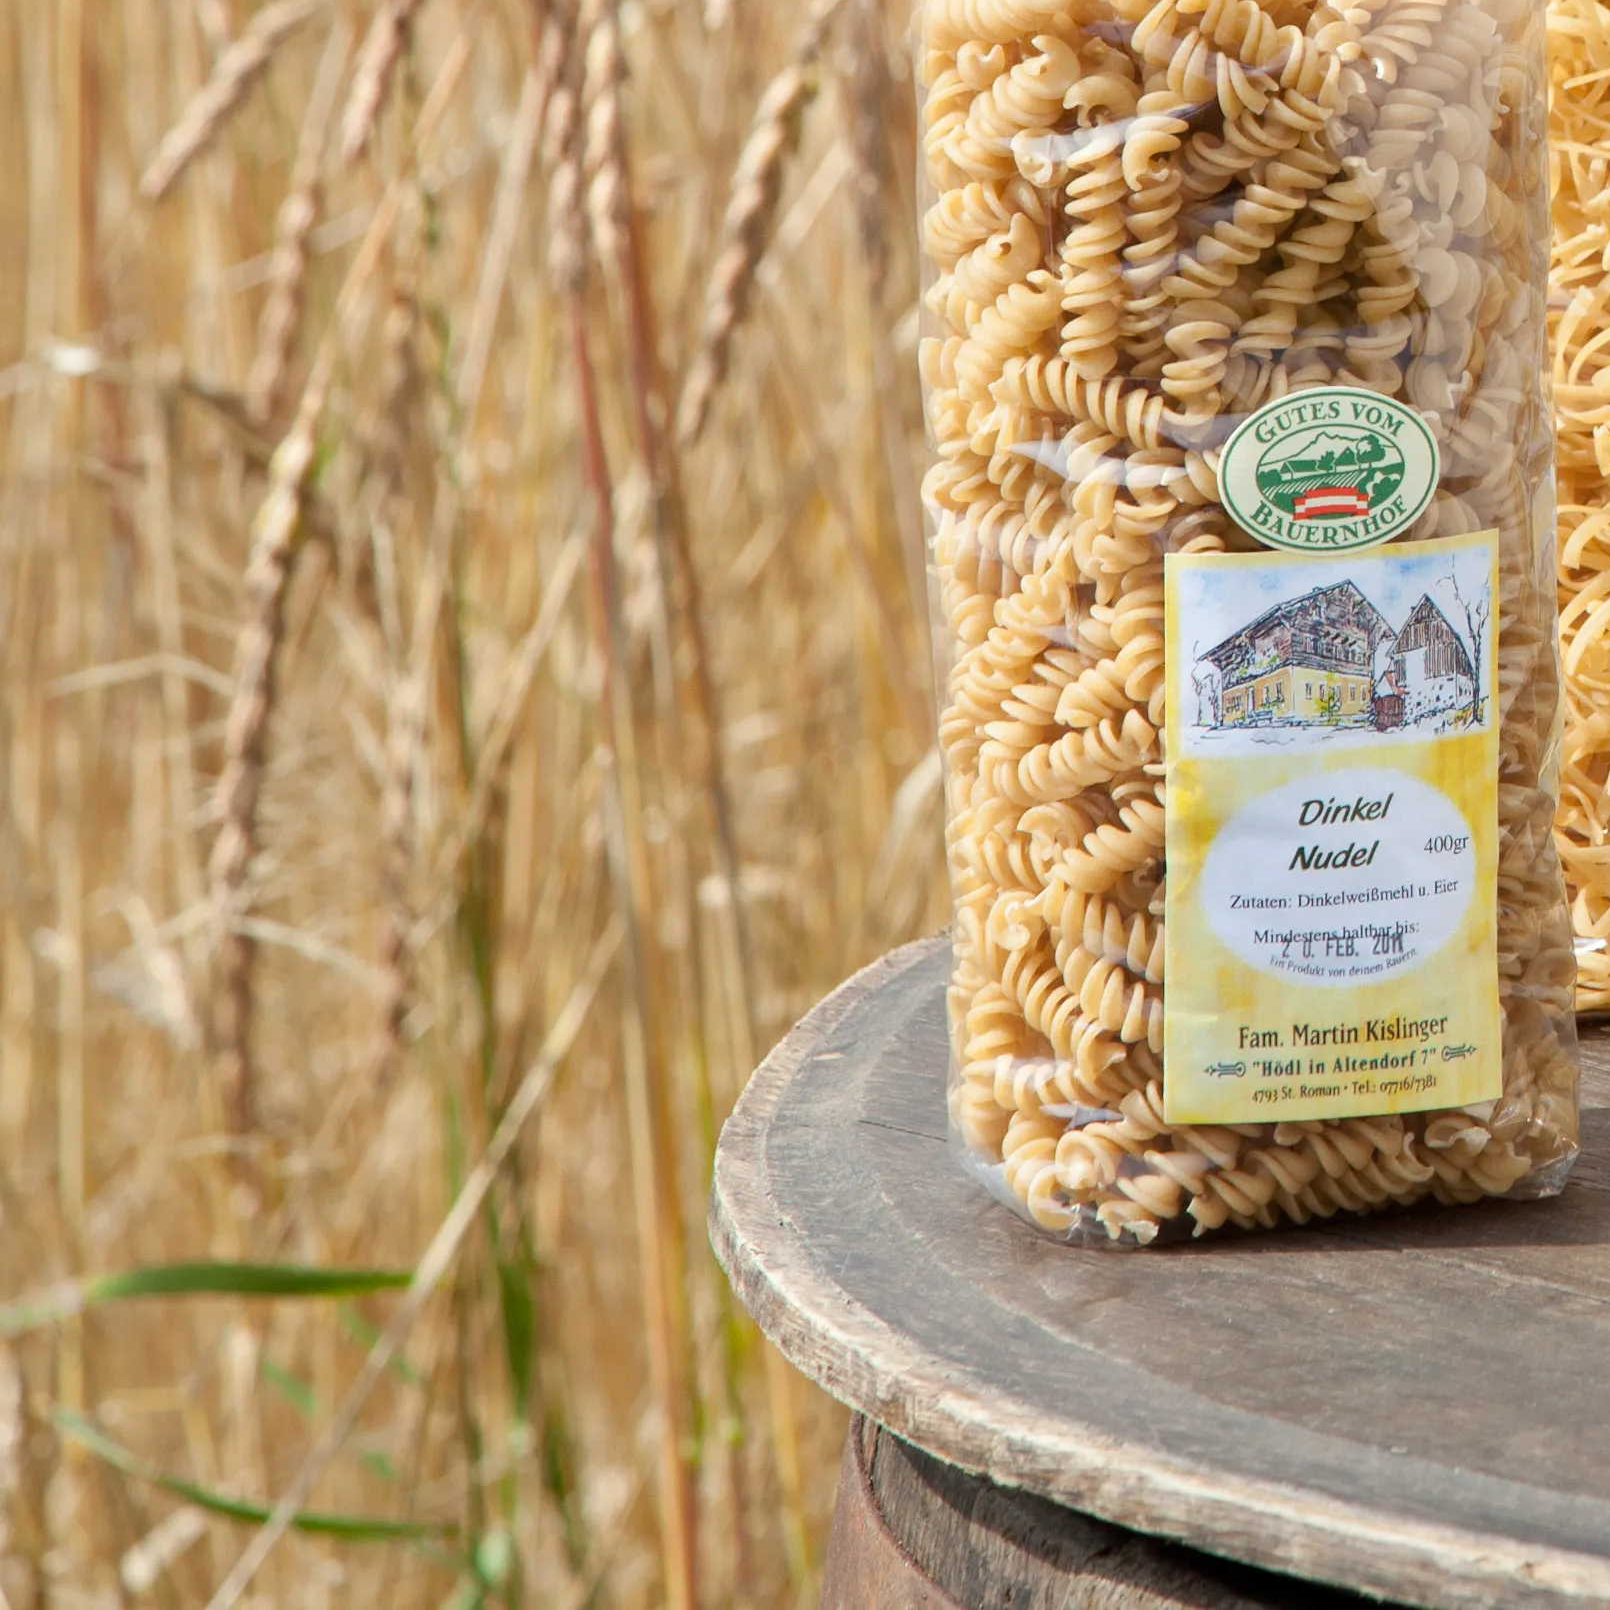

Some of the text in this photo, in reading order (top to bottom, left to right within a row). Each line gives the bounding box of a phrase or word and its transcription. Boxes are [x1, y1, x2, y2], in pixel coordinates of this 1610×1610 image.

[1255, 401, 1405, 443] GUTES VOM
[1249, 494, 1407, 545] BAUERNHOF
[1298, 793, 1394, 826] Dinkel
[1288, 835, 1469, 870] Nudel 400gr
[1230, 880, 1458, 909] Zutaten: Dinkelweißmehl u. Eier
[1253, 921, 1419, 945] Mindestens haltbar bis:
[1326, 938, 1359, 957] FEB.
[1269, 949, 1417, 977] Ein Produkt von deinem Bauern
[1238, 1015, 1448, 1049] Fam. Martin Kislinger
[1252, 1048, 1436, 1077] "Hödl in Altendorf 7"
[1252, 1075, 1437, 1103] 4793 St. Roman Tel.: 07716/7381
